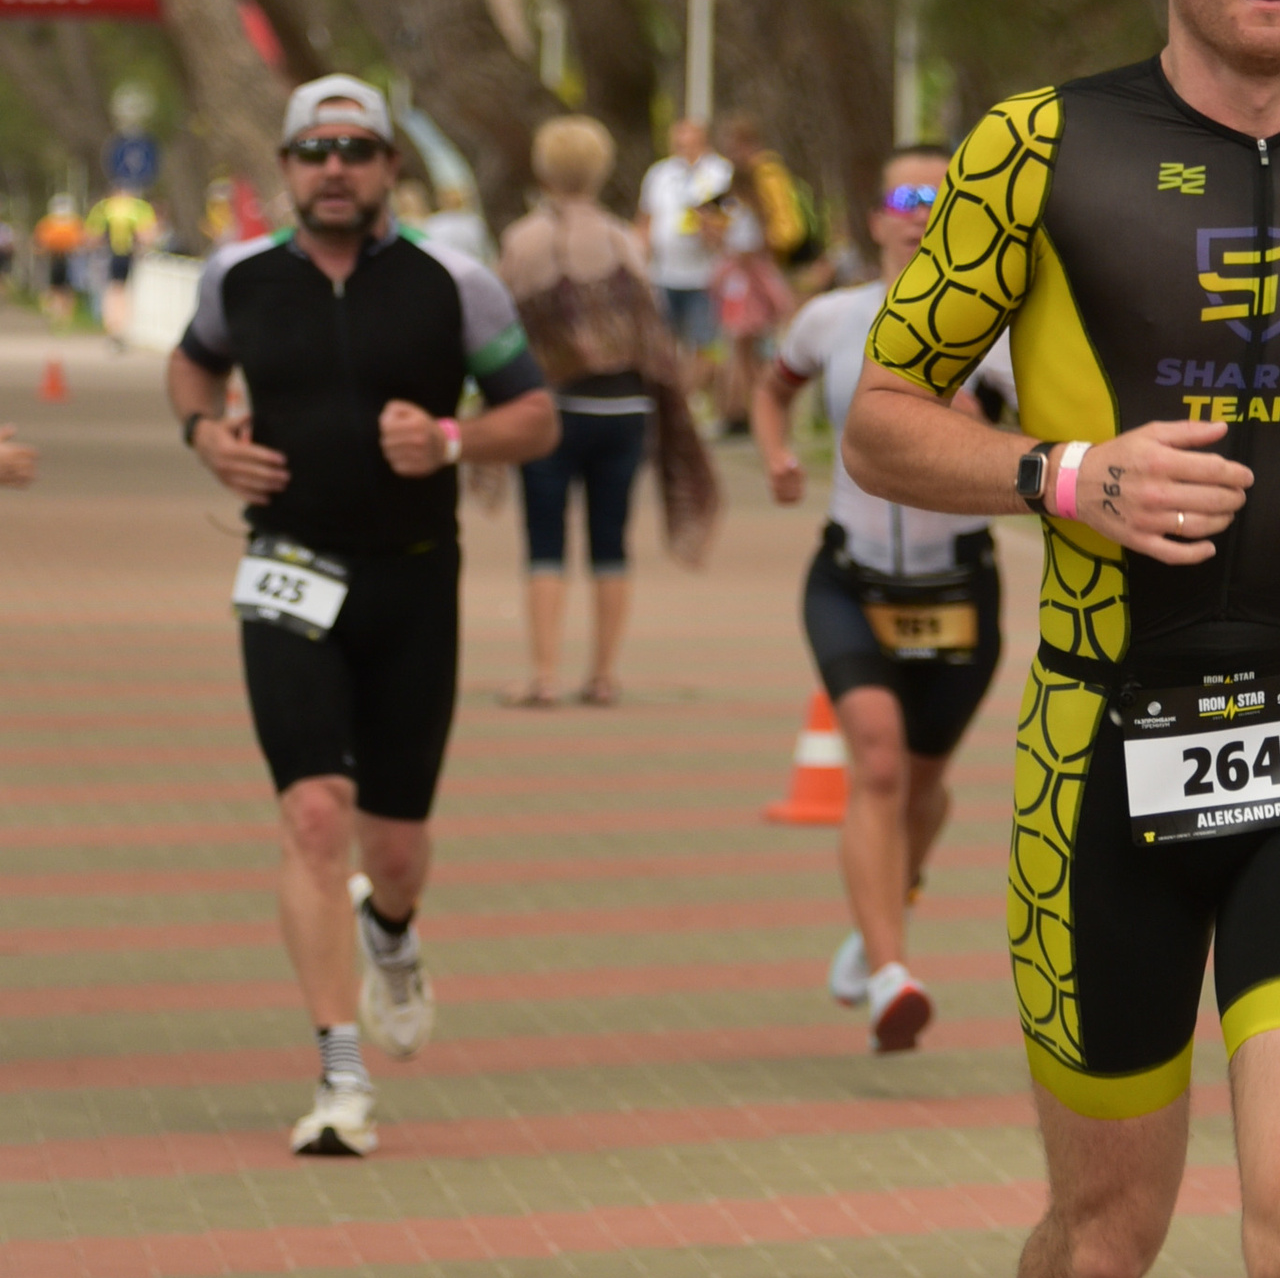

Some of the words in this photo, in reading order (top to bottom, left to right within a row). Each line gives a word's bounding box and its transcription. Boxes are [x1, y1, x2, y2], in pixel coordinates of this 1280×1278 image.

[1203, 674, 1224, 685] IRON
[1233, 671, 1256, 682] STAR
[1198, 695, 1226, 712] IRON
[1237, 690, 1266, 707] STAR
